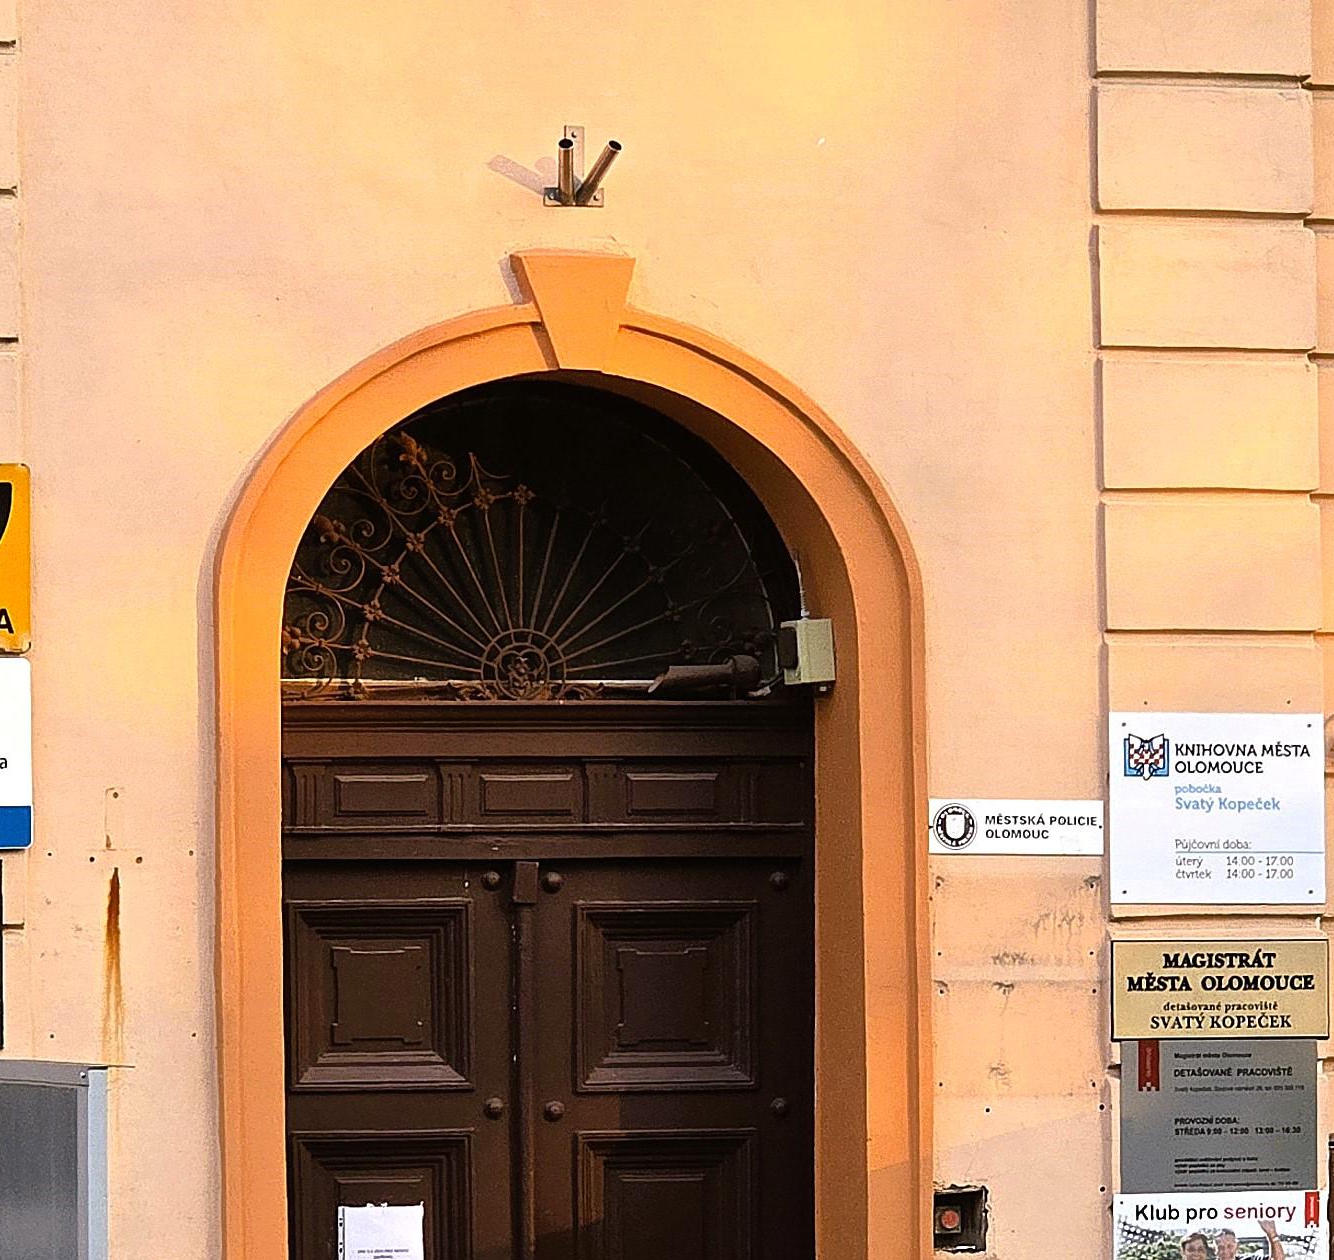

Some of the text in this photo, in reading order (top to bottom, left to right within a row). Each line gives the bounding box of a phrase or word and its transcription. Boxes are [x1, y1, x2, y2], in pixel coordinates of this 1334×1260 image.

[1174, 740, 1312, 758] KNIHOVNA MĚSTA
[1174, 760, 1265, 774] OLOMOUCE
[1174, 783, 1223, 796] pobočka
[1175, 796, 1281, 814] Svatý Kopeček
[984, 812, 1098, 827] MĚSTSKÁ POLICIE
[985, 828, 1050, 840] OLOMOUC
[1222, 838, 1252, 850] doba:
[1175, 868, 1213, 880] čtvrtek
[1162, 948, 1277, 969] MAGISTRÁT
[1126, 971, 1316, 992] MĚSTA OLOMOUCE
[1163, 1001, 1279, 1014] detašované pracoviště
[1149, 1012, 1292, 1030] SVATÝ KOPEČEK
[1173, 1065, 1293, 1078] DETAŠOVANÉ PRACOVIŠTĚ
[1135, 1203, 1180, 1221] Klub
[1186, 1209, 1218, 1225] pro
[1223, 1202, 1297, 1223] seniory
